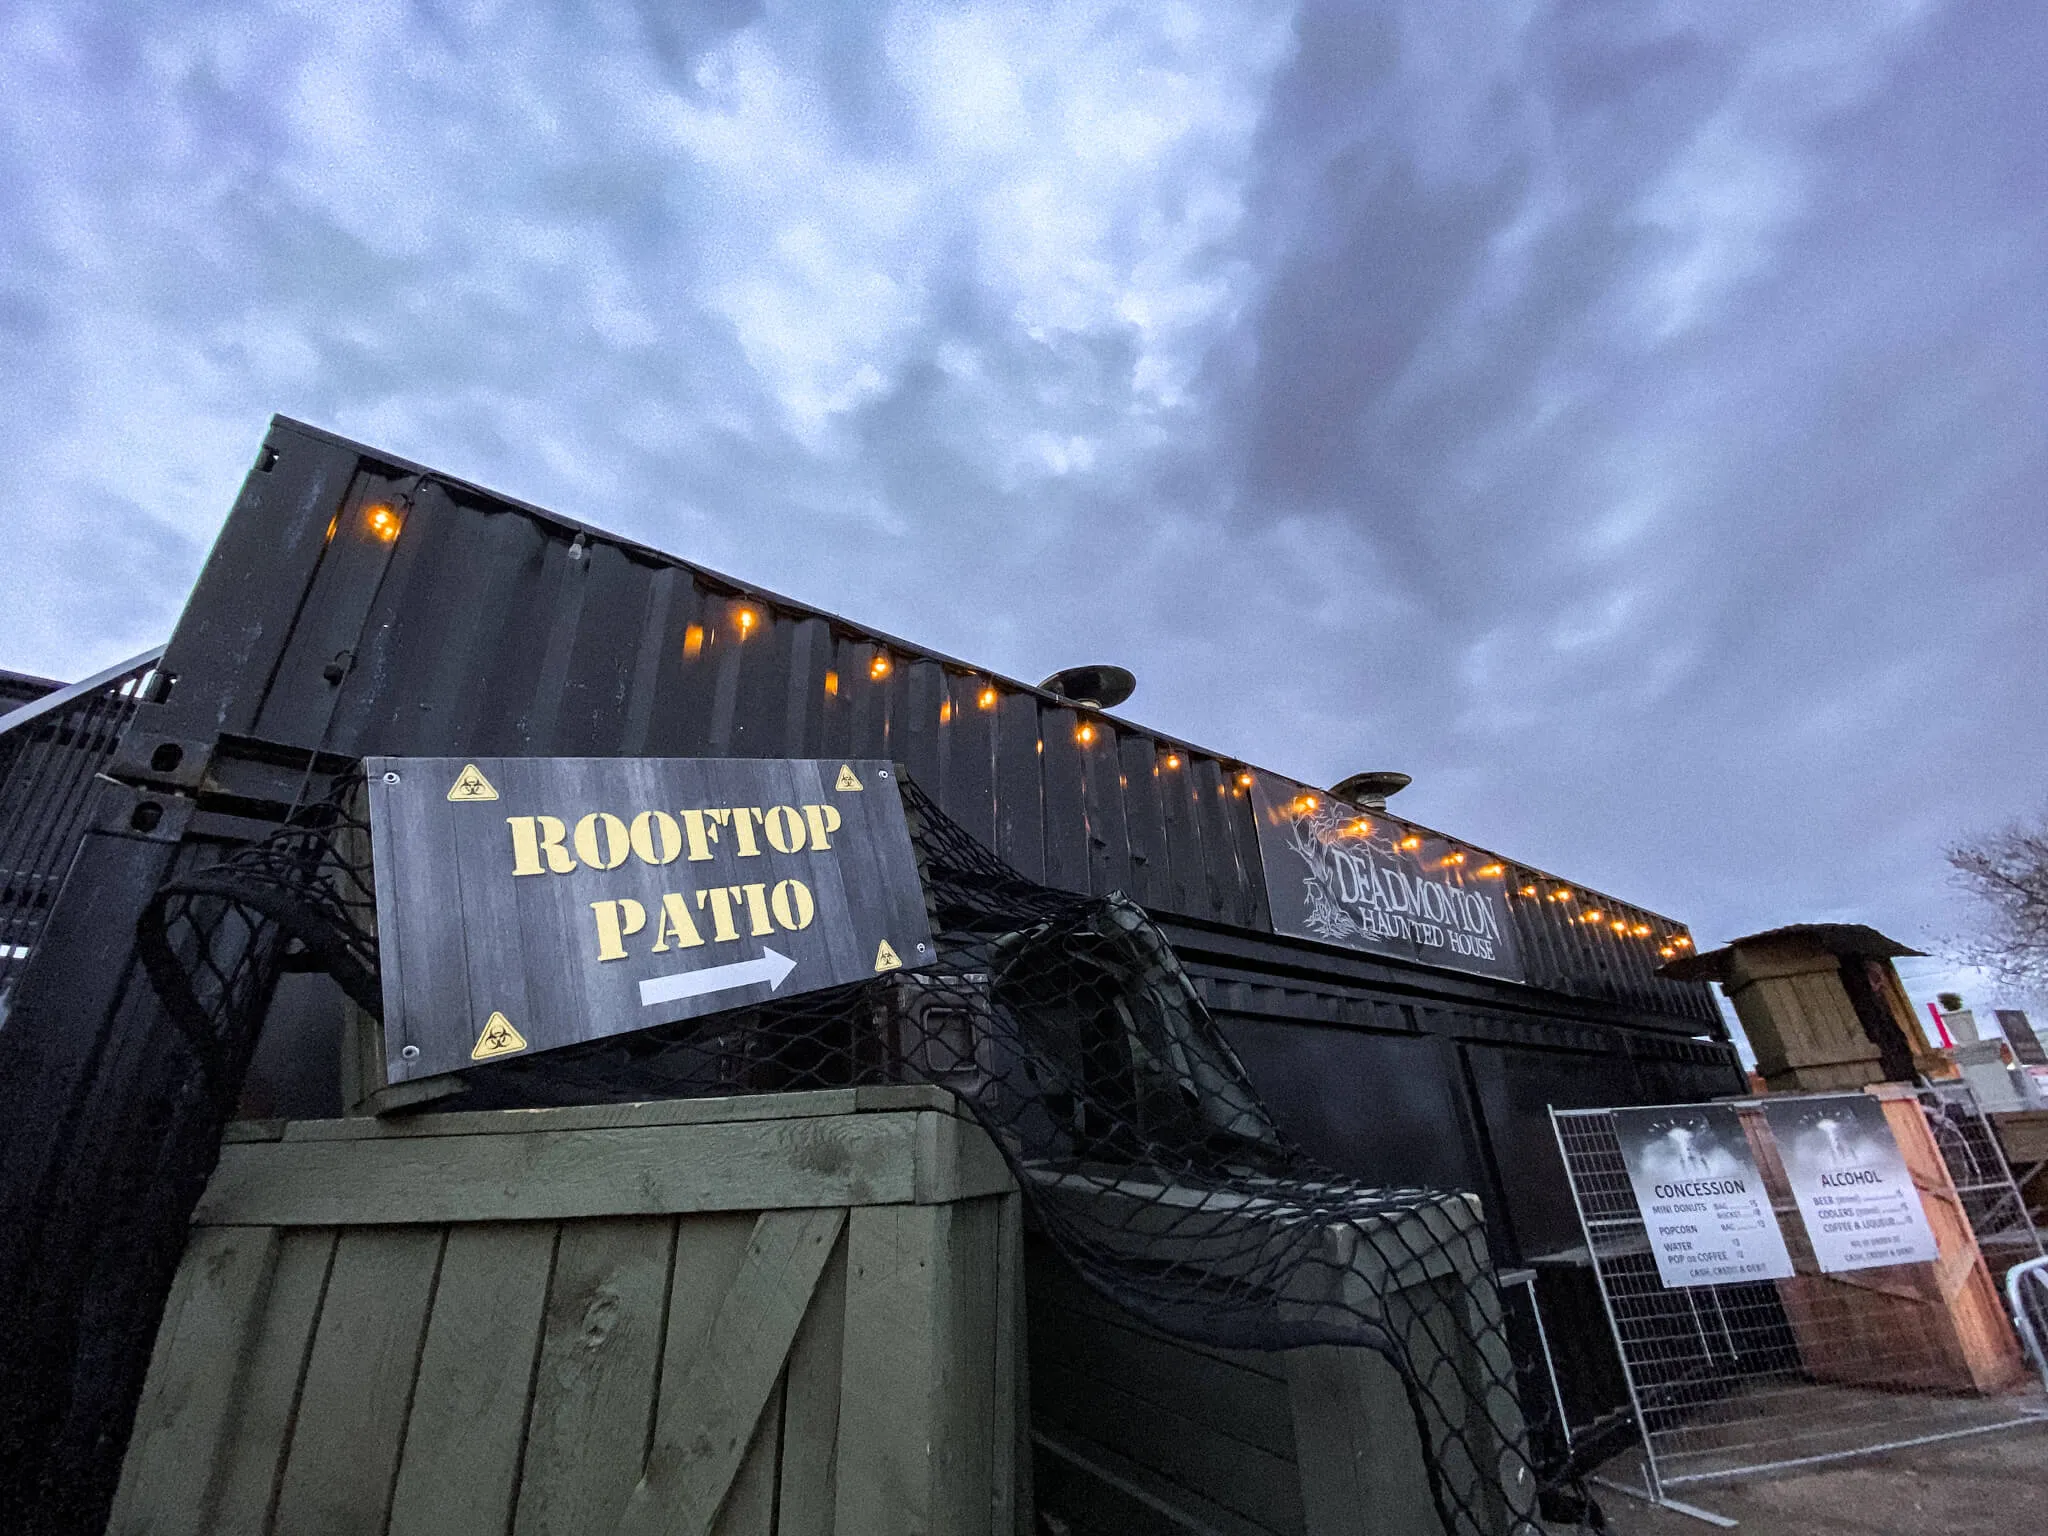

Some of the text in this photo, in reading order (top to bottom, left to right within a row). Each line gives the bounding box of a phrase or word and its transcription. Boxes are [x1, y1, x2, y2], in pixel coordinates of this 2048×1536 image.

[506, 804, 842, 876] ROOFTOP
[1333, 849, 1503, 946] DEADMONTON
[590, 879, 815, 961] PATIO
[1358, 906, 1496, 961] HAUNTED HOUSE
[1821, 1170, 1883, 1188] ALCOHOL
[1654, 1180, 1746, 1199] CONCESSION
[1812, 1196, 1834, 1206] BEER
[1652, 1205, 1673, 1215] MINI
[1674, 1203, 1708, 1213] DONUTS
[1818, 1208, 1855, 1219] COOLERS
[1659, 1225, 1698, 1236] POPCORN
[1823, 1221, 1853, 1233] COFFEE
[1663, 1241, 1693, 1252] WATER
[1668, 1255, 1685, 1265] POP
[1697, 1251, 1728, 1262] COFFEE
